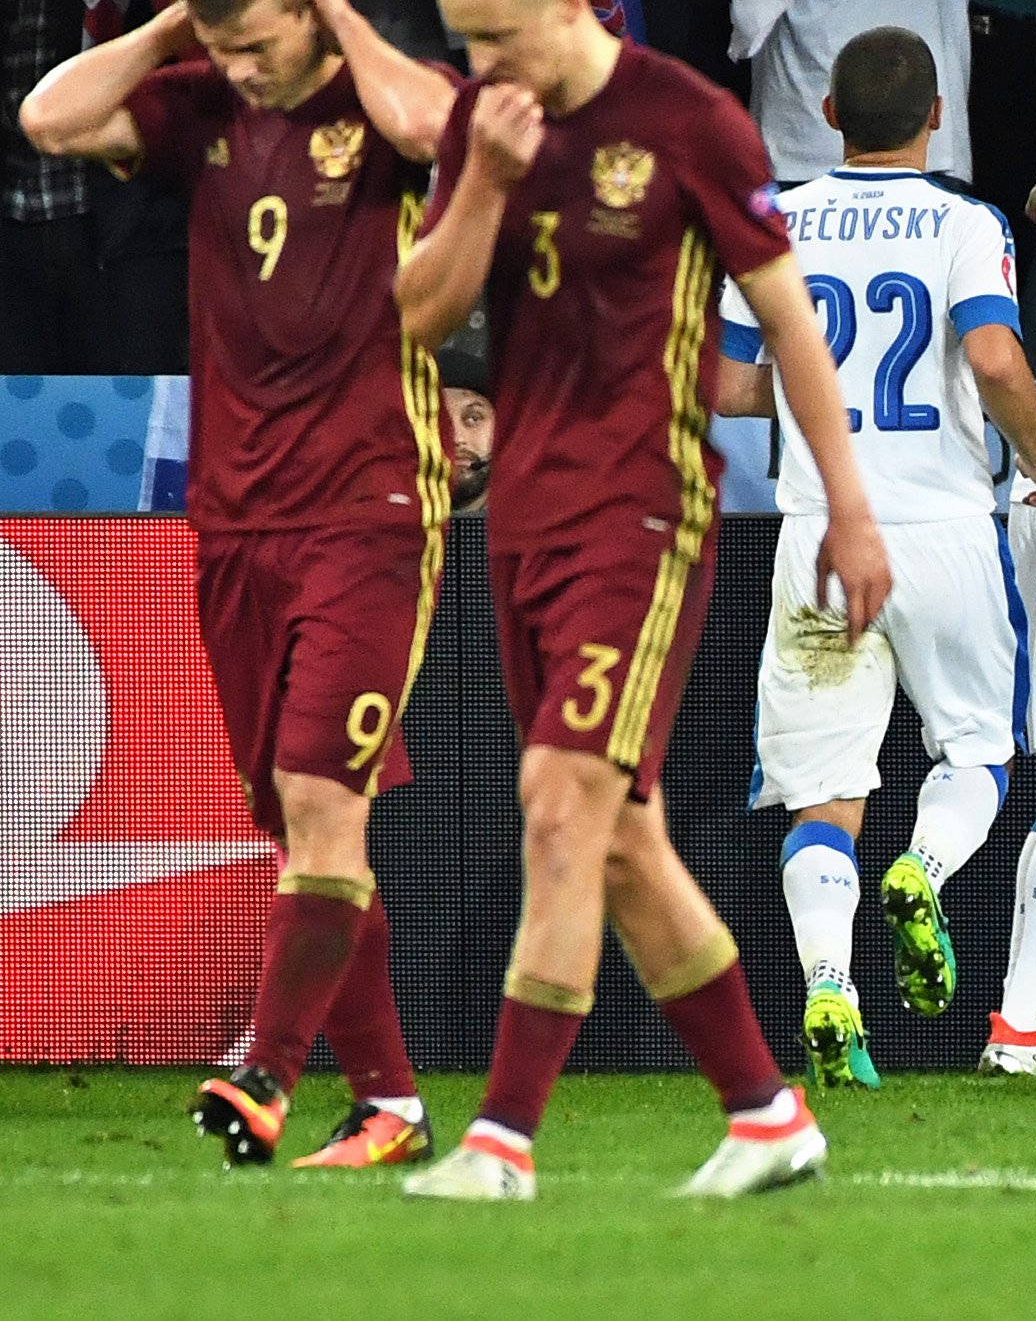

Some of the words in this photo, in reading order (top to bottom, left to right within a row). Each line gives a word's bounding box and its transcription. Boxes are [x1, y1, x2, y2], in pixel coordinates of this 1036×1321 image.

[247, 194, 288, 282] 9
[528, 210, 562, 300] 3
[346, 691, 392, 771] 9
[562, 642, 622, 732] 3
